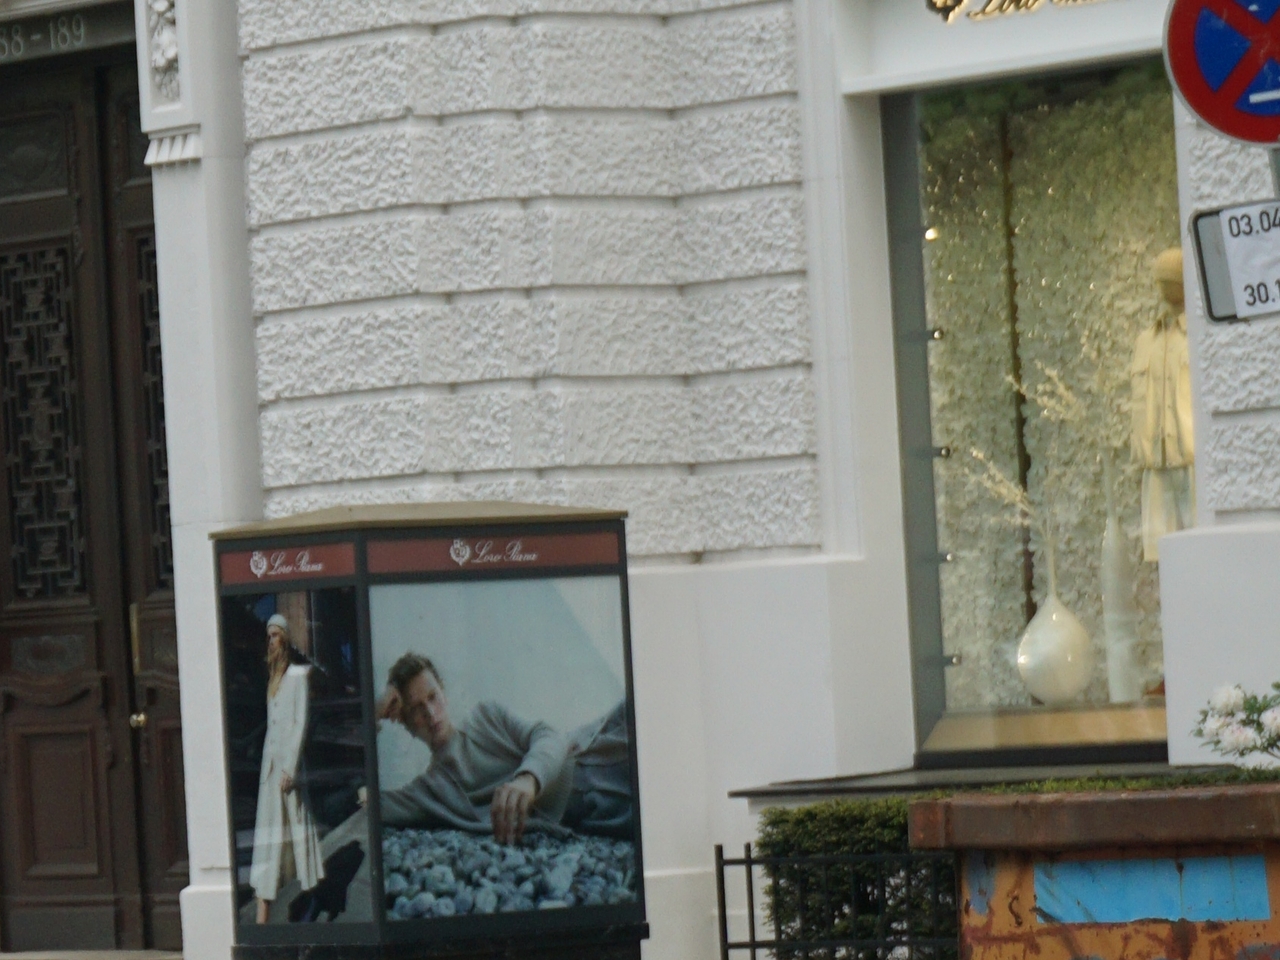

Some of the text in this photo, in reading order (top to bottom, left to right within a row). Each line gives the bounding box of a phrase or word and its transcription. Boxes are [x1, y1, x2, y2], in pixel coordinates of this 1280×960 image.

[49, 14, 85, 51] 189
[267, 549, 324, 575] Loro Piana
[472, 540, 539, 563] Loro Piana
